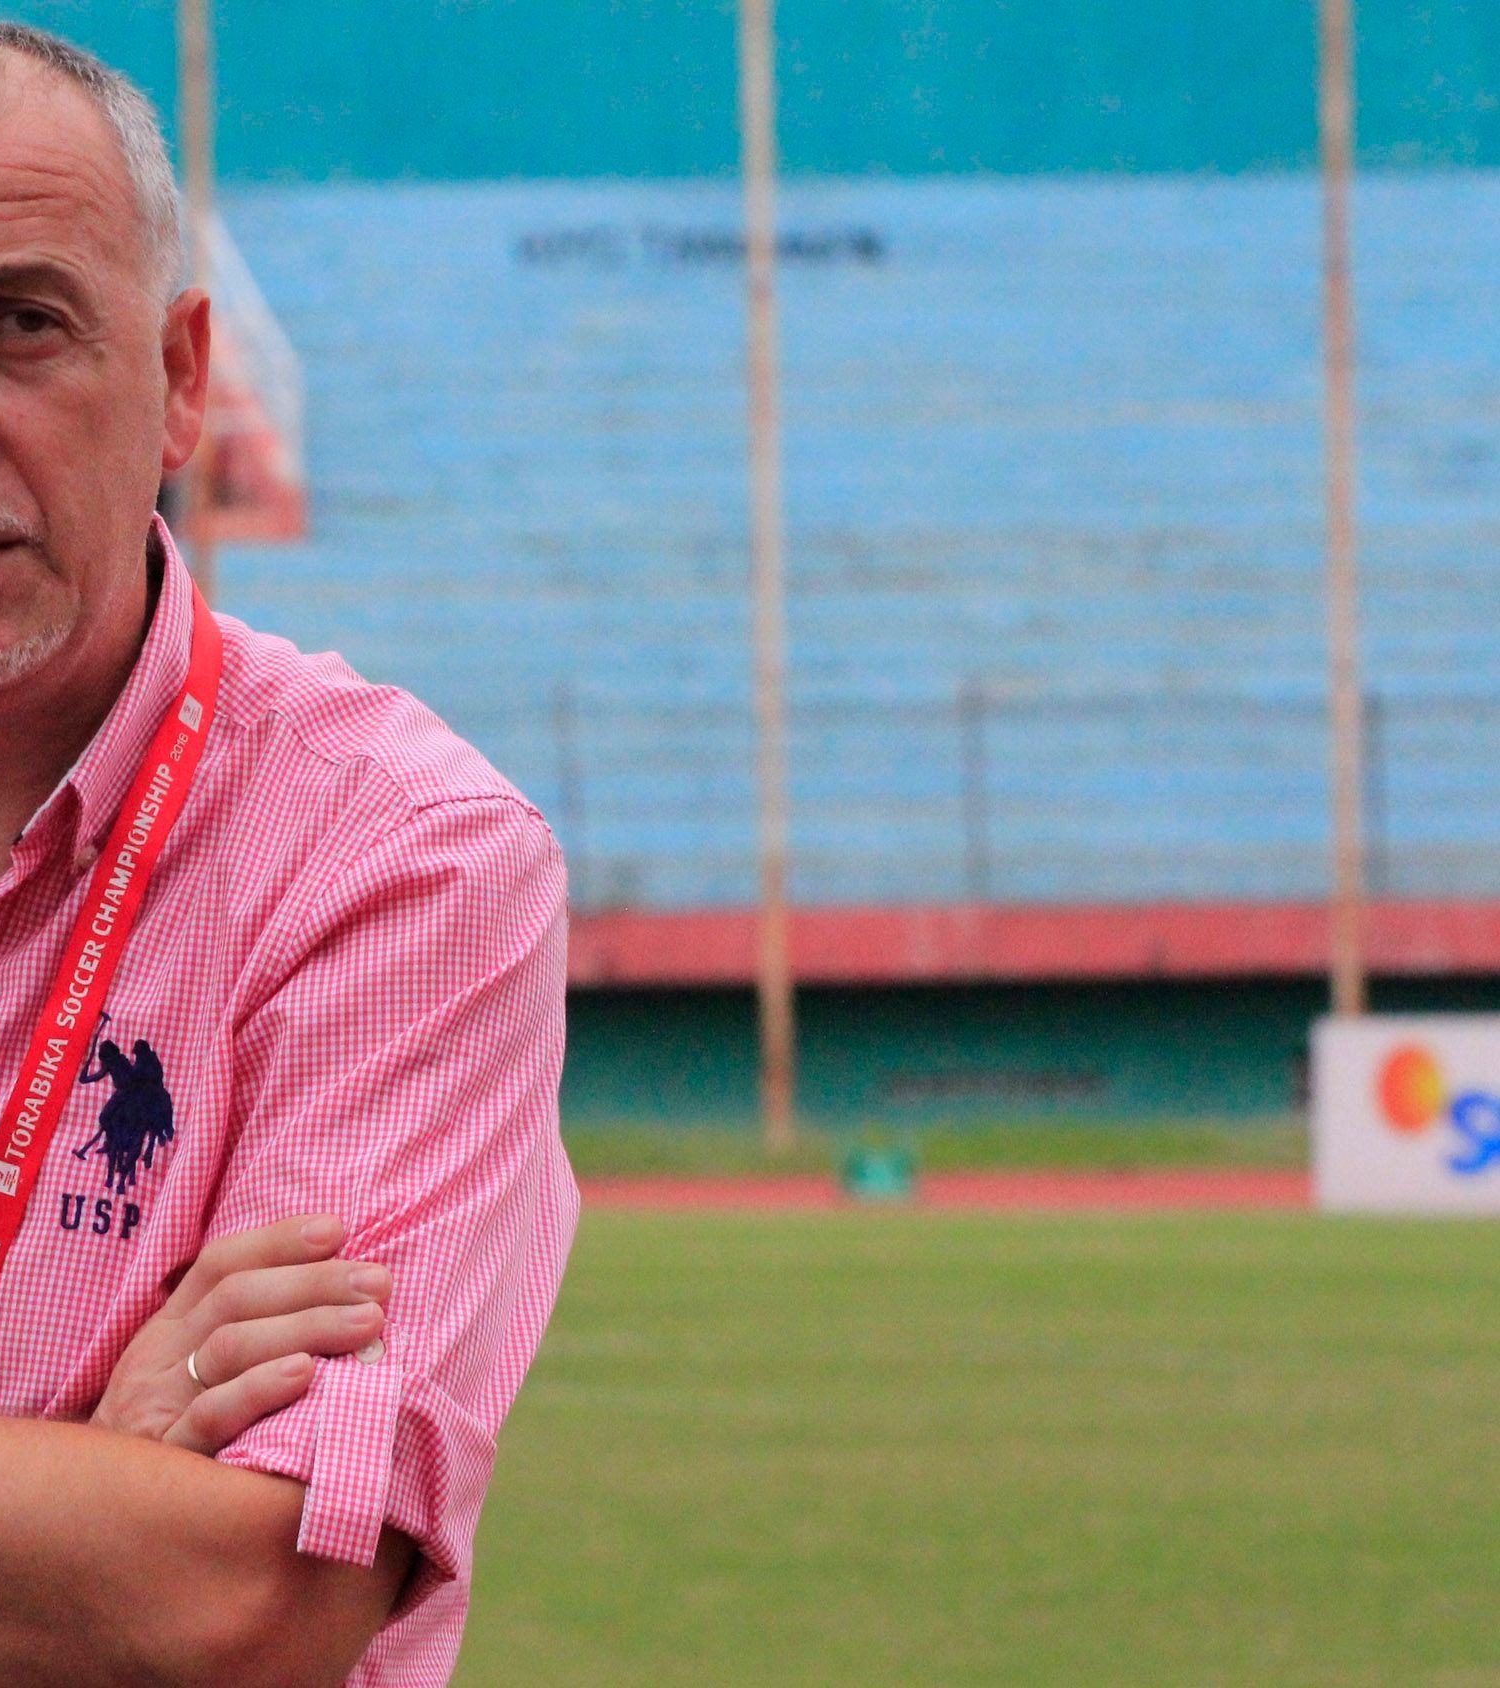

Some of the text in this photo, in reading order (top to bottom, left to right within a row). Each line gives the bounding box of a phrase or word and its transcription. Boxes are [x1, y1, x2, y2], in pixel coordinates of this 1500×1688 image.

[5, 1038, 69, 1162] TORABIKA
[56, 939, 106, 1030] SOCCER
[91, 763, 175, 937] CHAMPIONSHIP
[169, 733, 189, 762] 2016
[60, 1193, 140, 1239] USP
